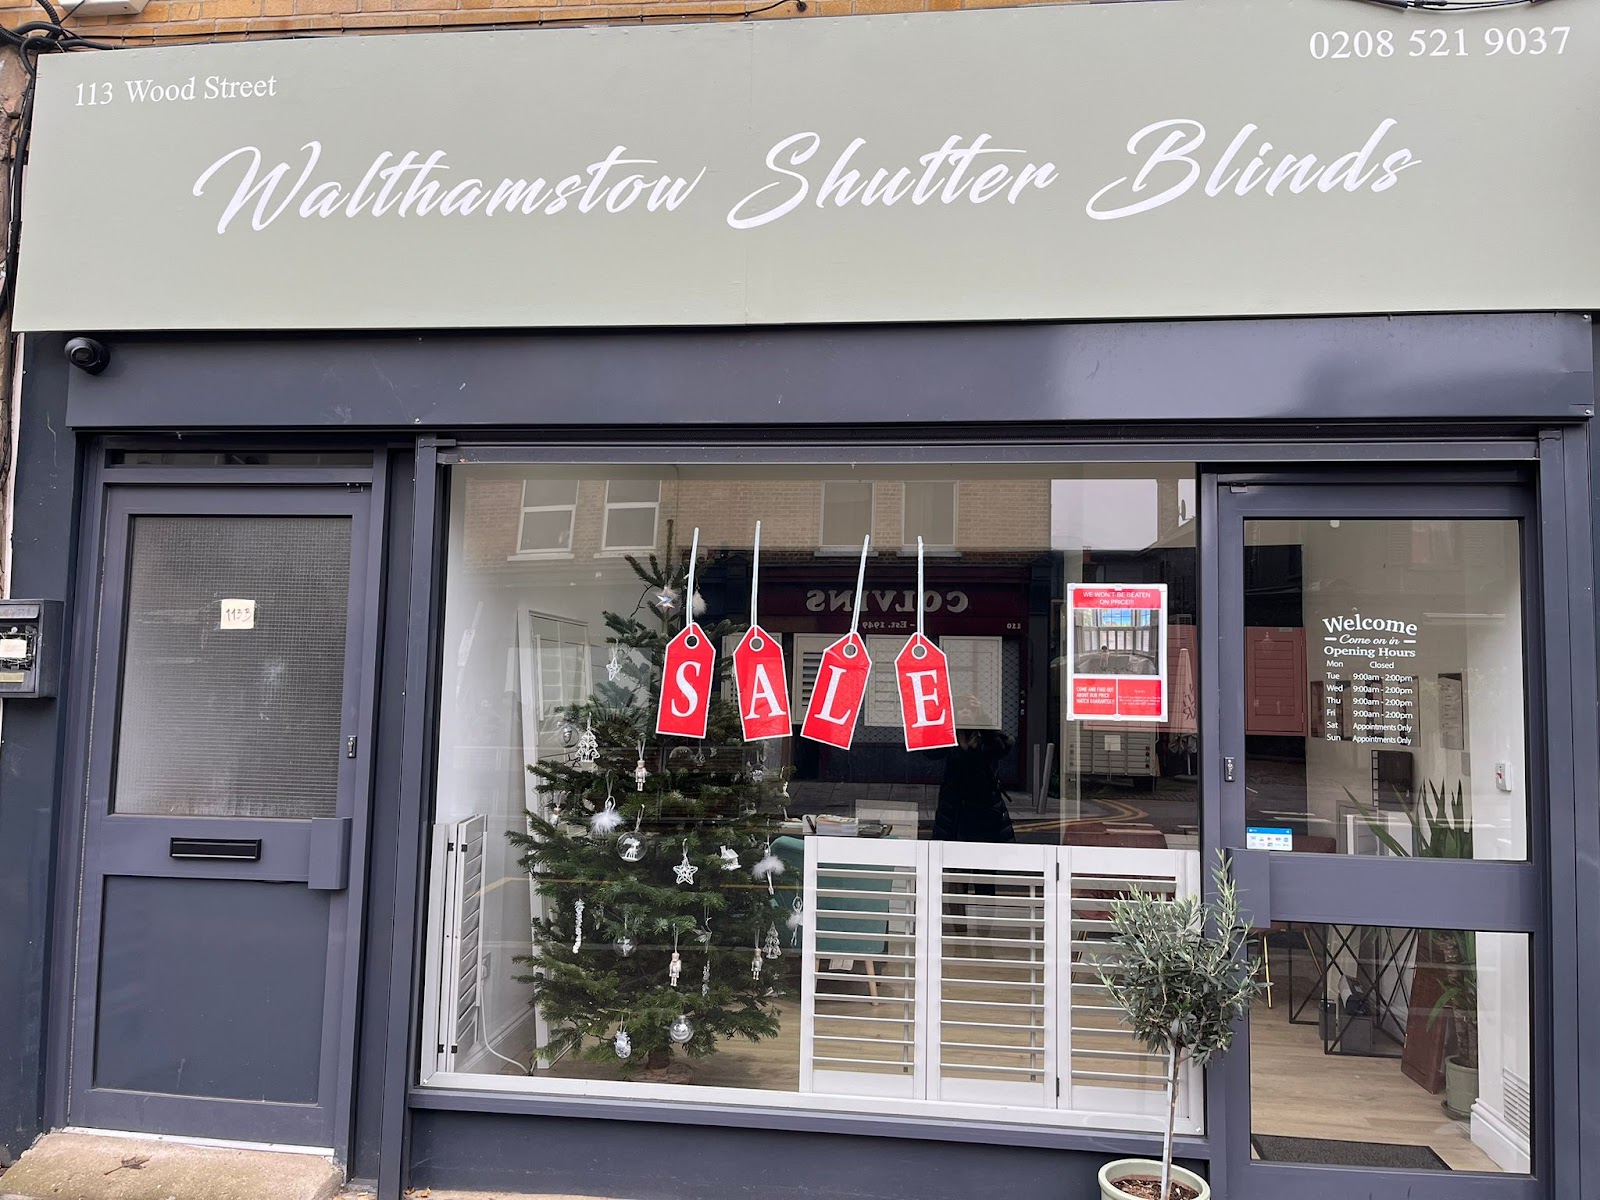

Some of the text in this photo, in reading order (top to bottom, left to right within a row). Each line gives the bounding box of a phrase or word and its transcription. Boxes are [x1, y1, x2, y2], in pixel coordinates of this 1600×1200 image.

[1309, 26, 1571, 59] 0208 521 9037
[75, 75, 277, 106] 113 Wood Street
[192, 117, 1423, 235] Walthamstow Shutter Blinds
[1322, 613, 1418, 636] Welcome
[1339, 634, 1371, 645] Come
[1388, 636, 1400, 645] in
[1324, 646, 1416, 658] Opening Hours
[1326, 660, 1395, 669] Mon Closed
[1326, 672, 1340, 680] Tue
[1353, 673, 1380, 681] 9:00am
[1385, 674, 1413, 683] 2:00pm
[1326, 684, 1344, 692] Wed
[1353, 685, 1380, 693] 9:00am
[1385, 686, 1413, 695] 2:00pm
[1353, 697, 1380, 705] 9:00am
[1385, 698, 1413, 707] 2:00pm
[1326, 709, 1336, 717] Fri
[1353, 710, 1380, 718] 9:00am
[1385, 711, 1413, 720] 2:00pm
[1326, 721, 1412, 733] Sat Appointments Only
[1353, 735, 1396, 744] Appointments
[1397, 736, 1412, 745] Only
